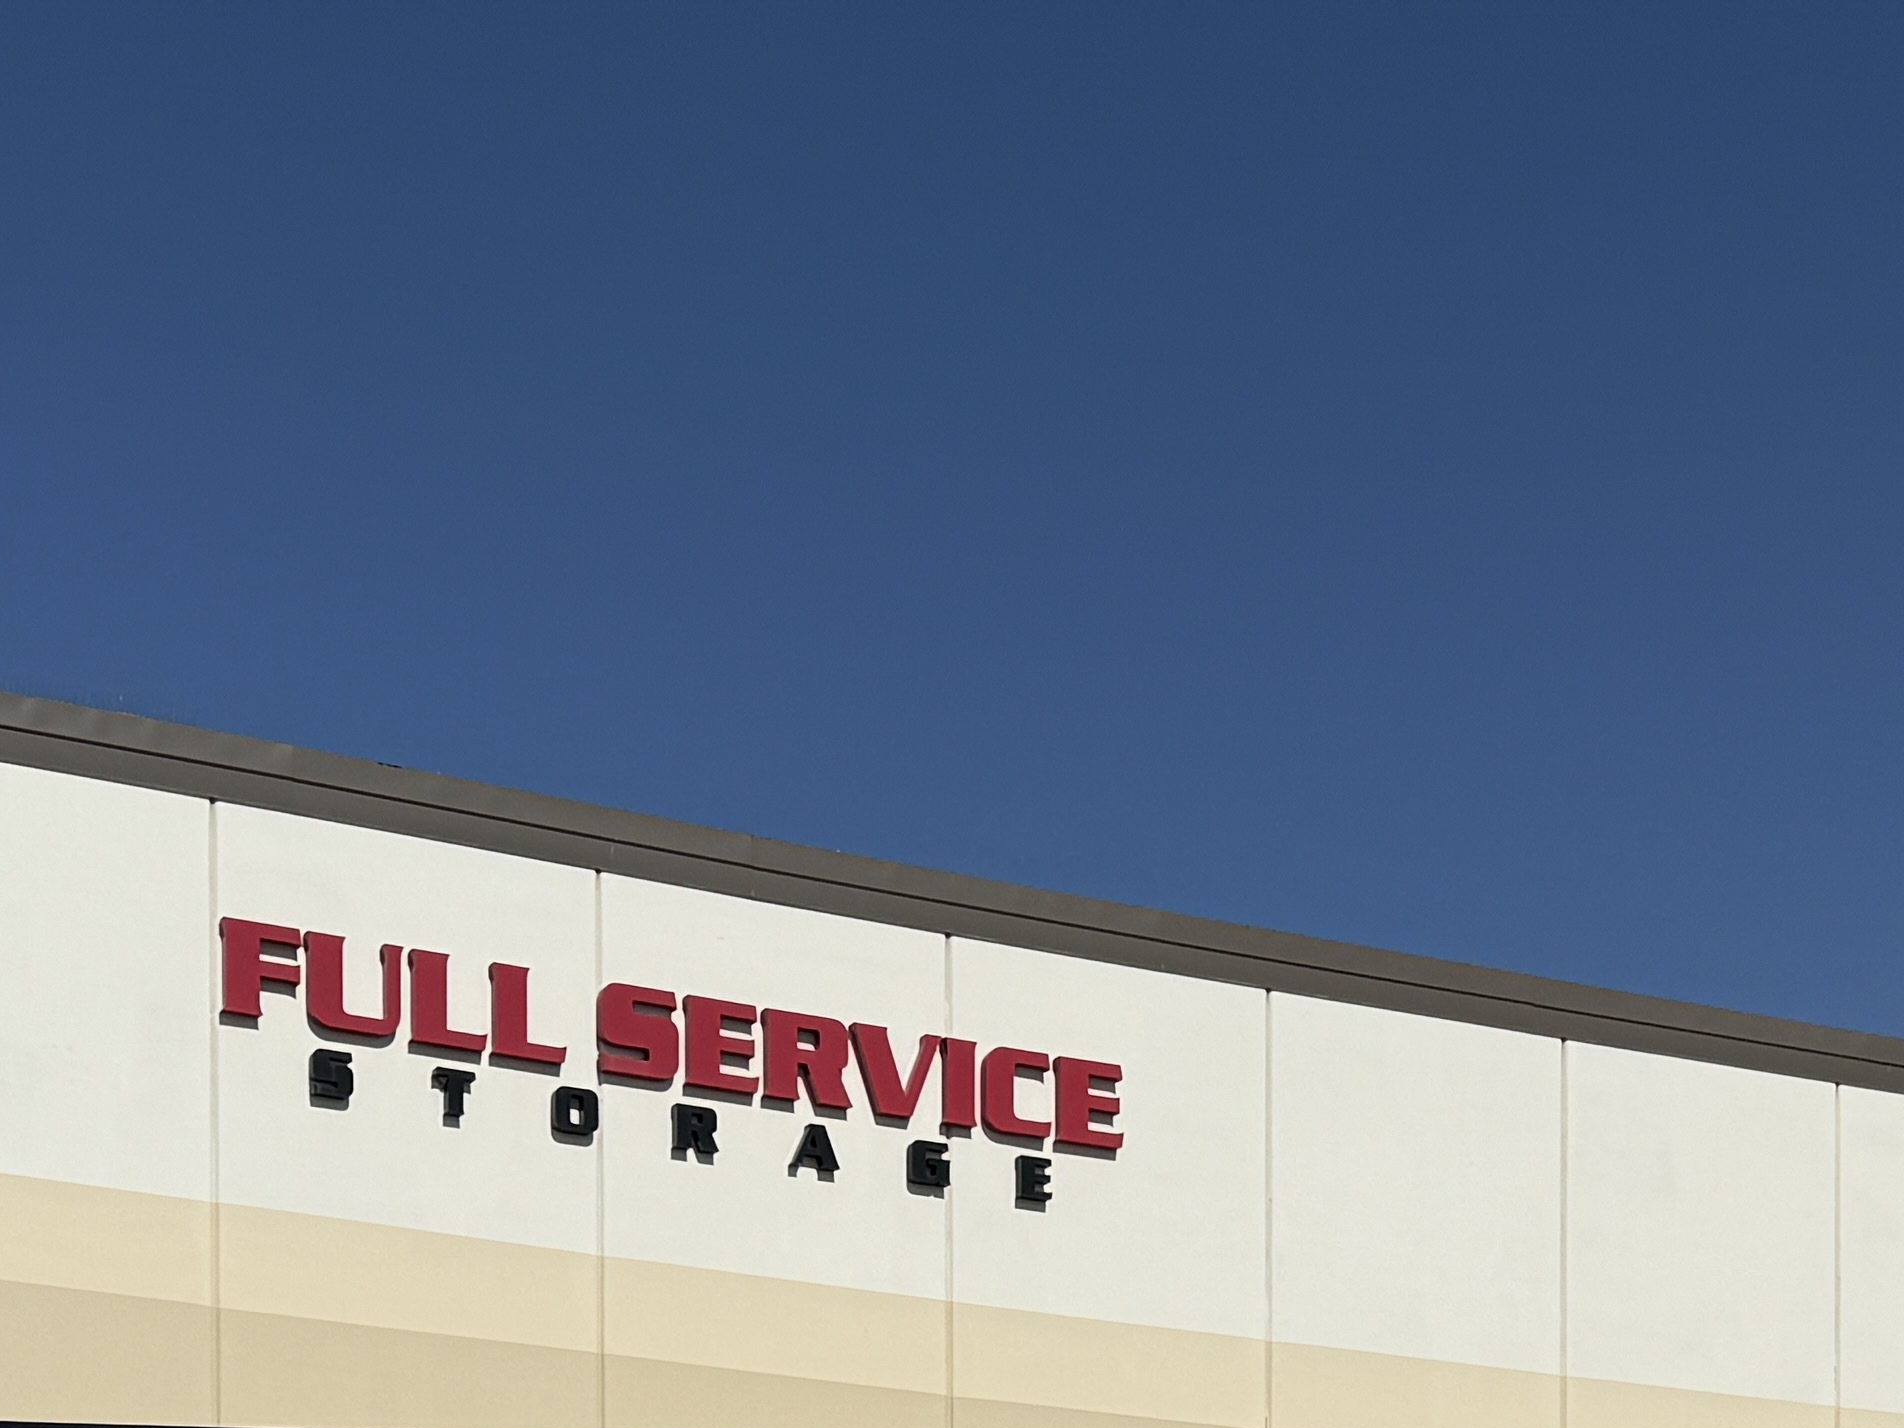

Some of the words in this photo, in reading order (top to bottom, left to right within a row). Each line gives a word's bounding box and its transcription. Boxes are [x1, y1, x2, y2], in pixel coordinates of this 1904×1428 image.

[218, 916, 567, 1066] FULL
[596, 981, 1125, 1151] SERVICE
[308, 1049, 1054, 1203] STORAGE
